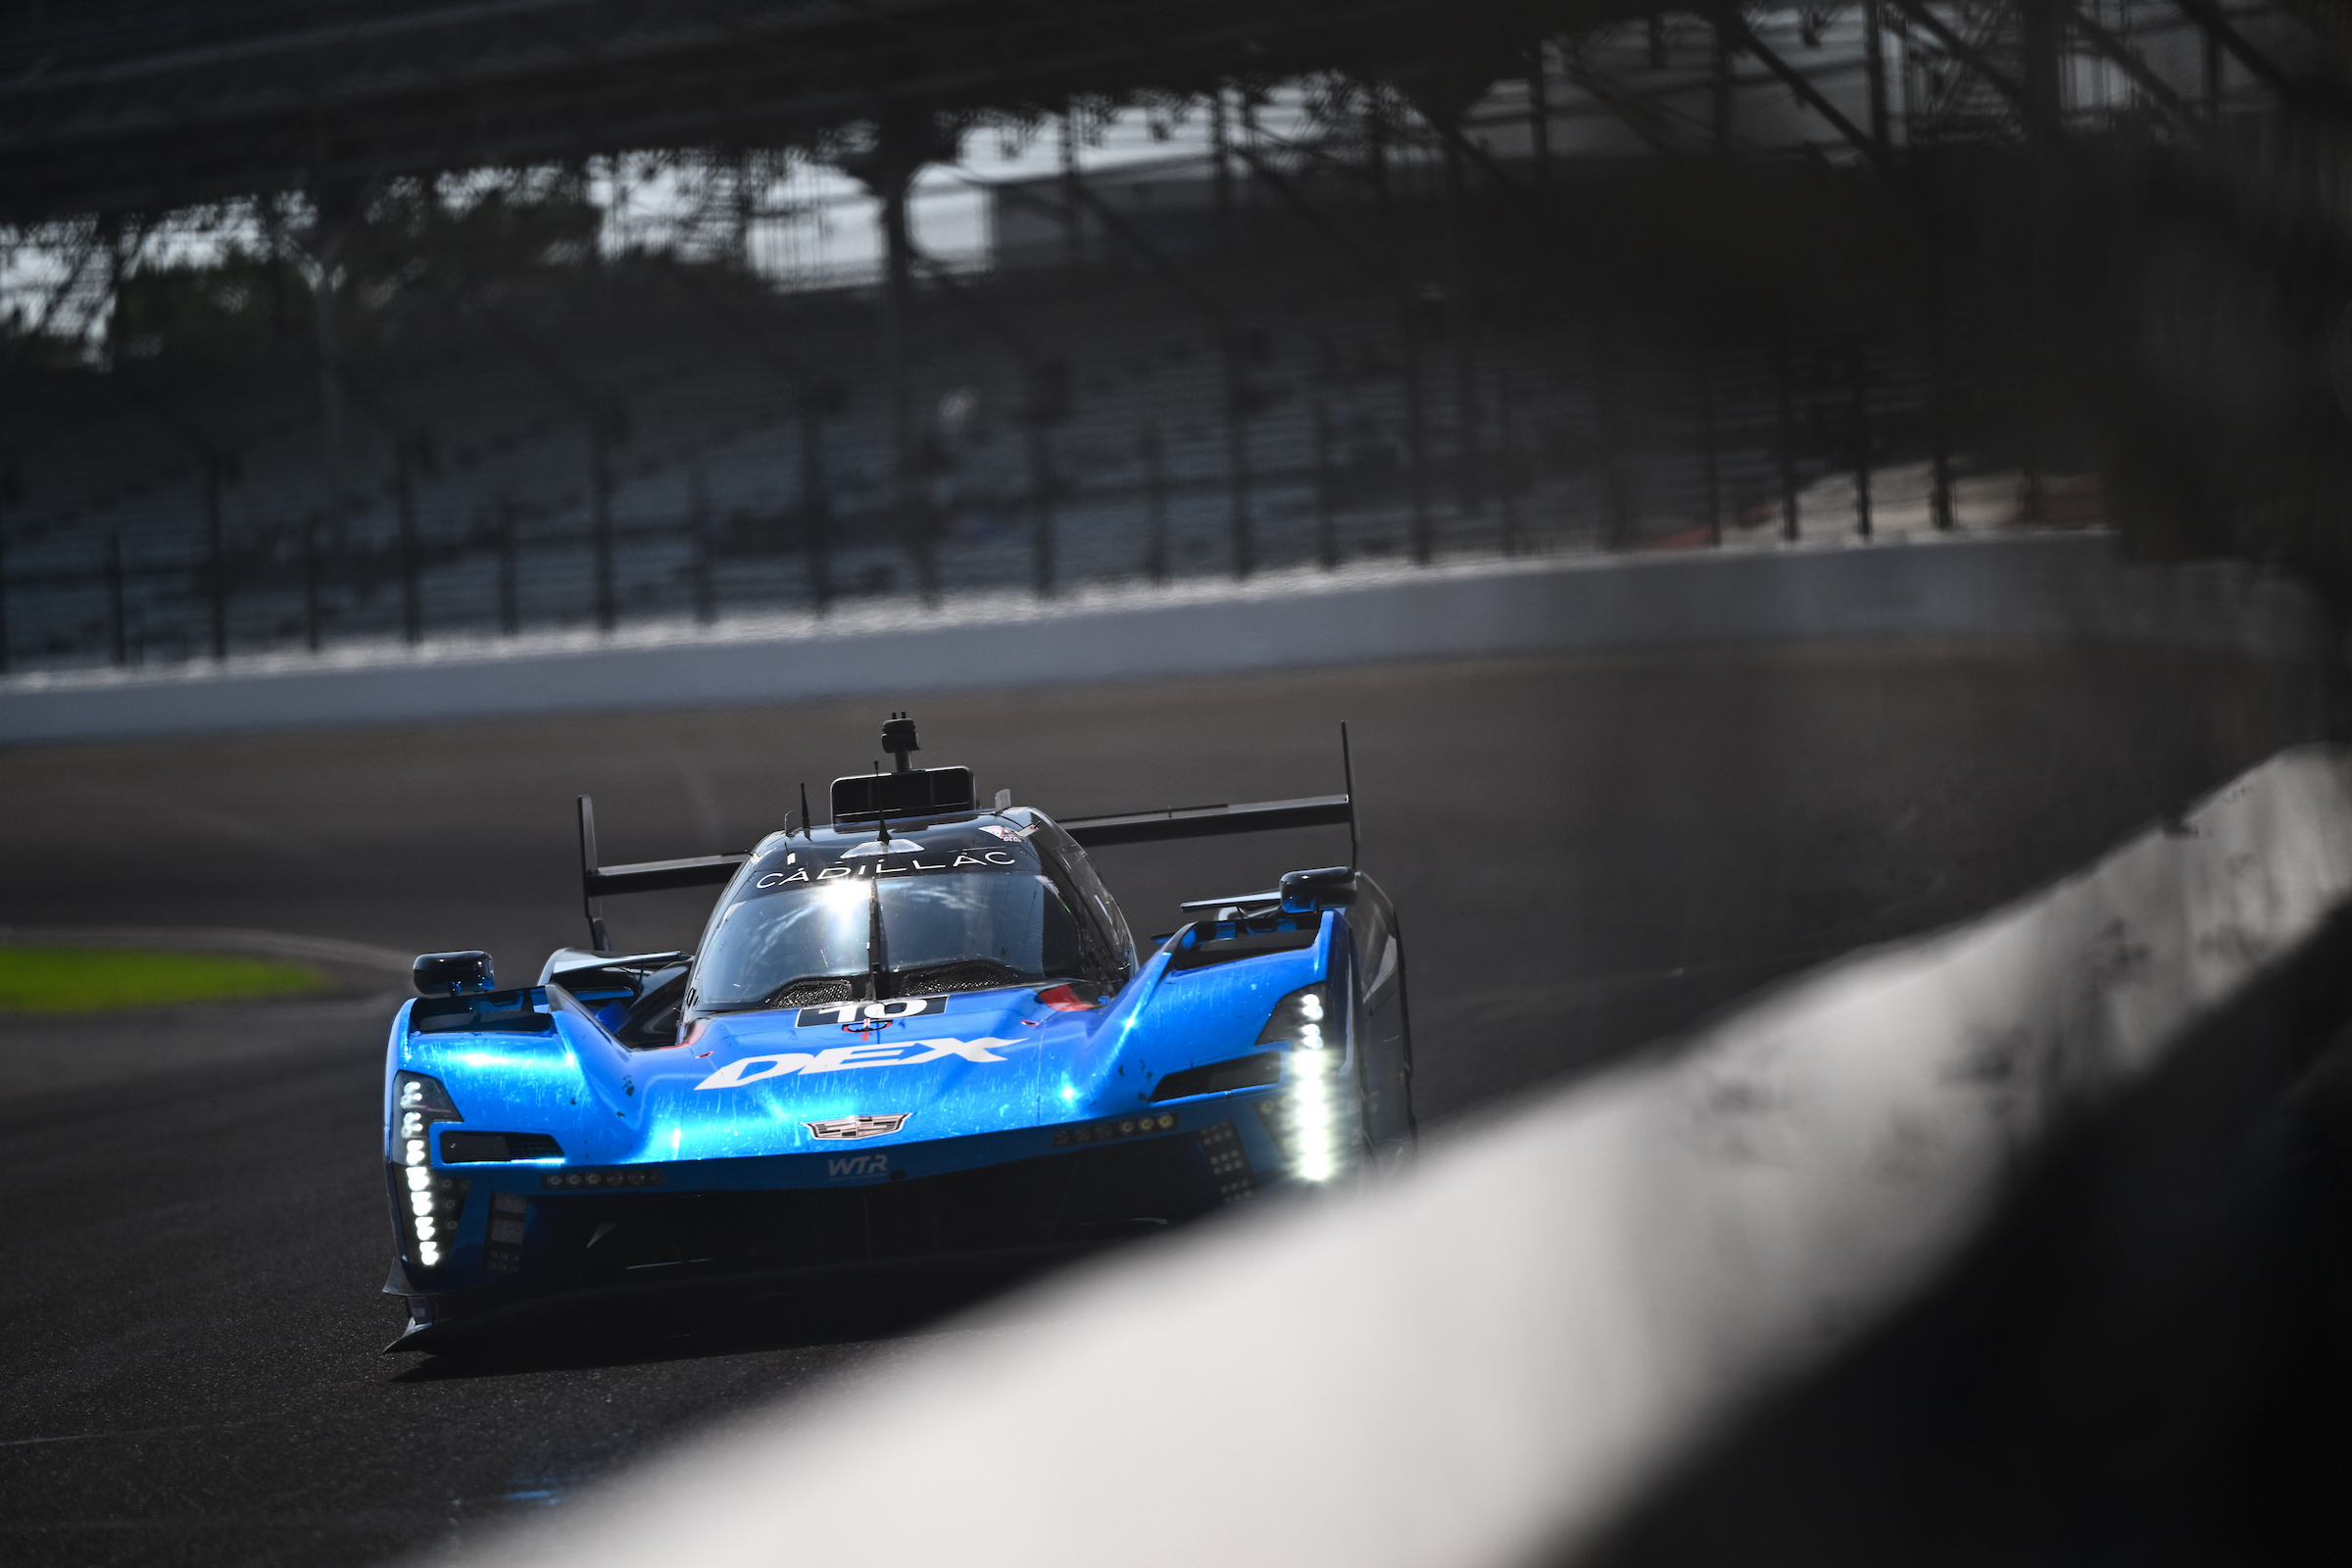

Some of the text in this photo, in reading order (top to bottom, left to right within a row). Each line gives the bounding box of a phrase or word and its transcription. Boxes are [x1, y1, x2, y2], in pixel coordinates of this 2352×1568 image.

[757, 851, 1015, 889] CADILLAC
[818, 998, 928, 1023] 10
[694, 1037, 1029, 1090] DEX
[828, 1154, 888, 1176] WTR
